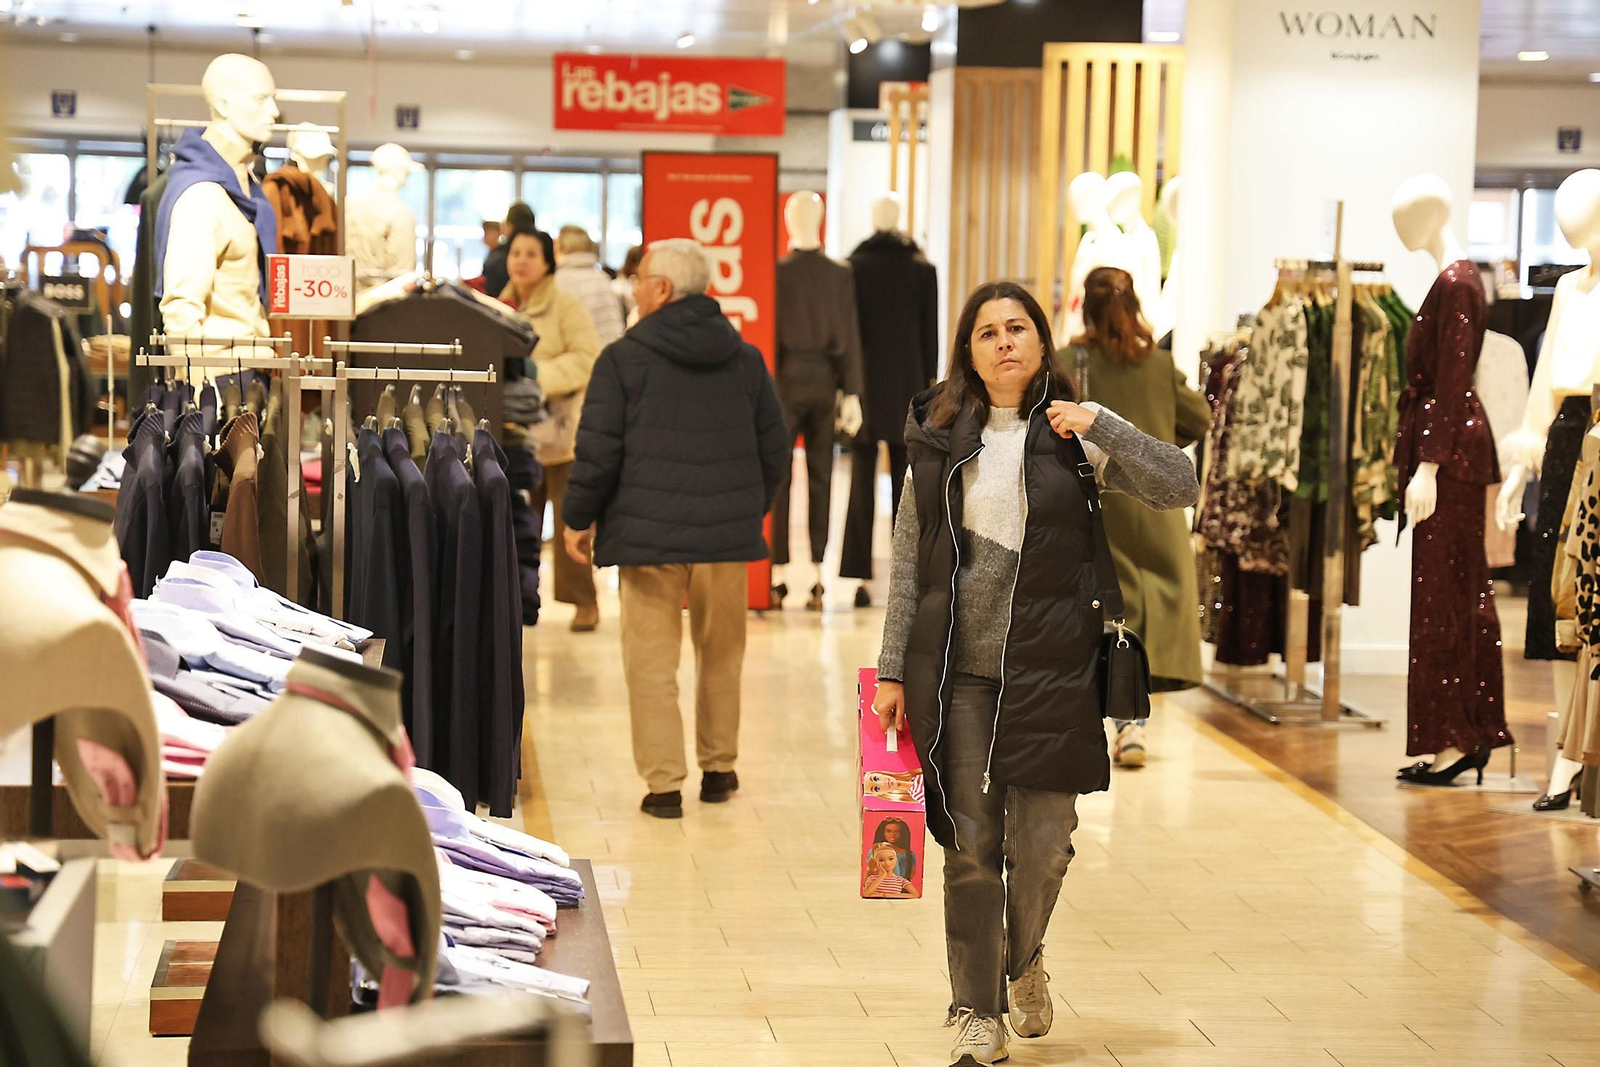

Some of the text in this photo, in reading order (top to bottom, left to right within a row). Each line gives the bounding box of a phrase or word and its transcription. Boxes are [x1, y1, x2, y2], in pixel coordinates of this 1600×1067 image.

[1278, 11, 1437, 39] WOMAN
[562, 70, 722, 121] rebajas
[294, 280, 347, 298] -30%
